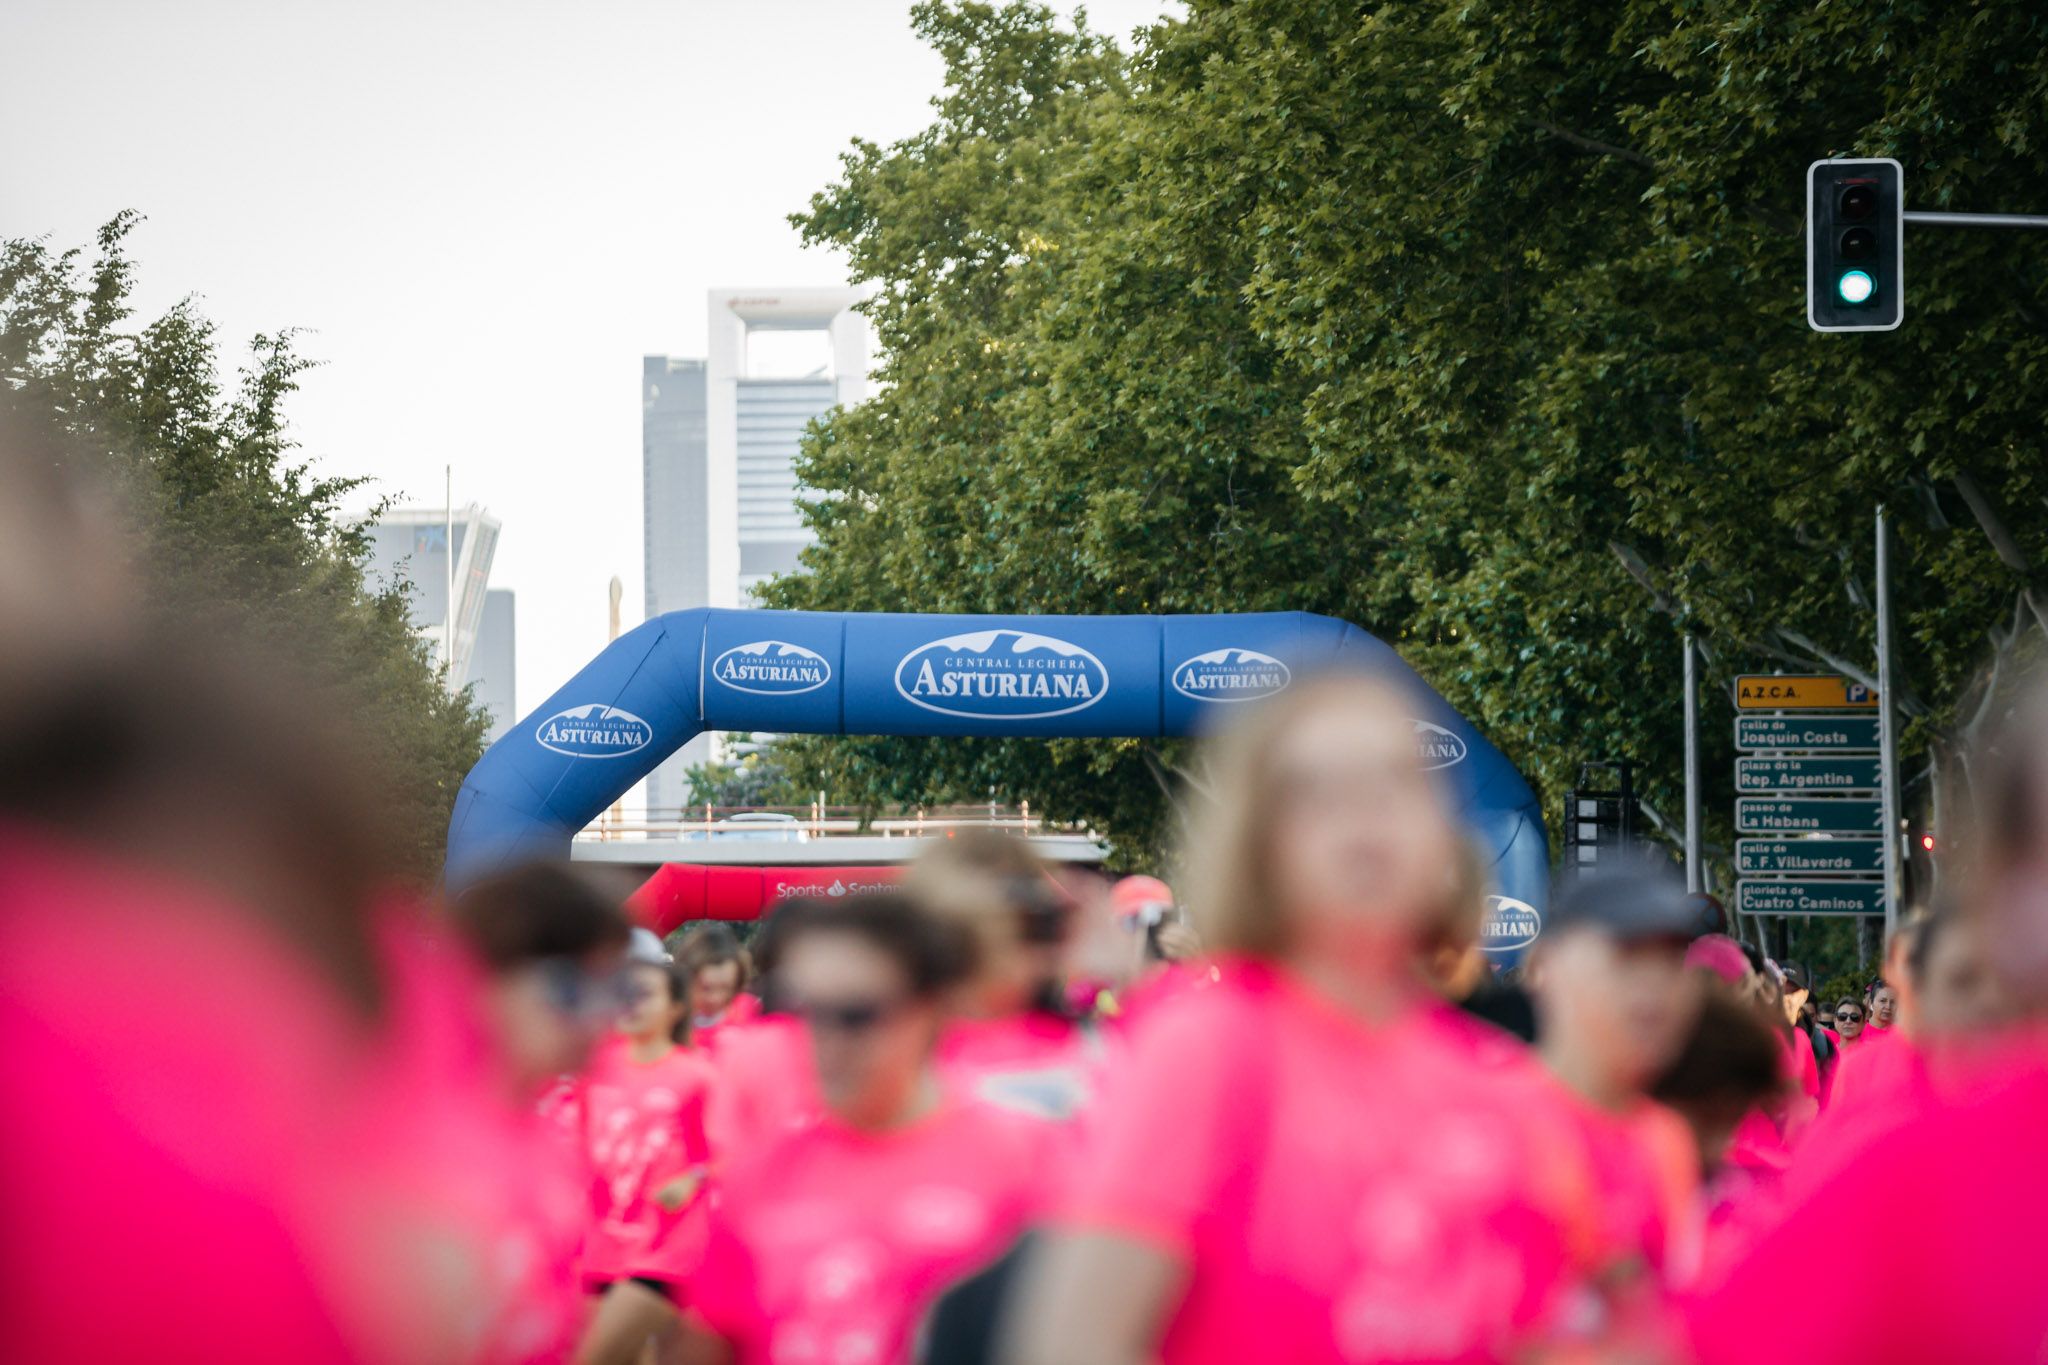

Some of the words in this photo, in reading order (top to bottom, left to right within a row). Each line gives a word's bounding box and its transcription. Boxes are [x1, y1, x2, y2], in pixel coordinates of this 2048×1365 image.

[740, 656, 777, 665] CENTRAL
[781, 658, 819, 667] LECHERA
[944, 657, 1011, 668] CENTRAL
[1018, 658, 1086, 669] LECHERA
[1741, 686, 1800, 699] A.Z.C.A.
[562, 721, 598, 729] CENTRAL
[603, 722, 641, 731] LECHERA
[1741, 720, 1769, 730] calle
[1772, 720, 1786, 730] de
[1803, 731, 1848, 744] Costa
[1741, 761, 1772, 772] plaza
[1774, 761, 1789, 770] de
[1790, 761, 1802, 770] la
[1741, 773, 1775, 788] Rep.
[1779, 773, 1854, 788] Argentina
[1742, 804, 1776, 813] paseo
[1778, 803, 1793, 812] de
[1742, 815, 1759, 827] La
[1762, 815, 1820, 828] Habana
[1742, 844, 1770, 853] calle
[1773, 844, 1788, 853] de
[1776, 855, 1853, 868] Villaverde
[776, 882, 826, 899] Sports
[1743, 885, 1788, 896] glorieta
[1790, 885, 1805, 895] de
[1742, 896, 1795, 909] Cuatro
[1799, 897, 1865, 909] Caminos
